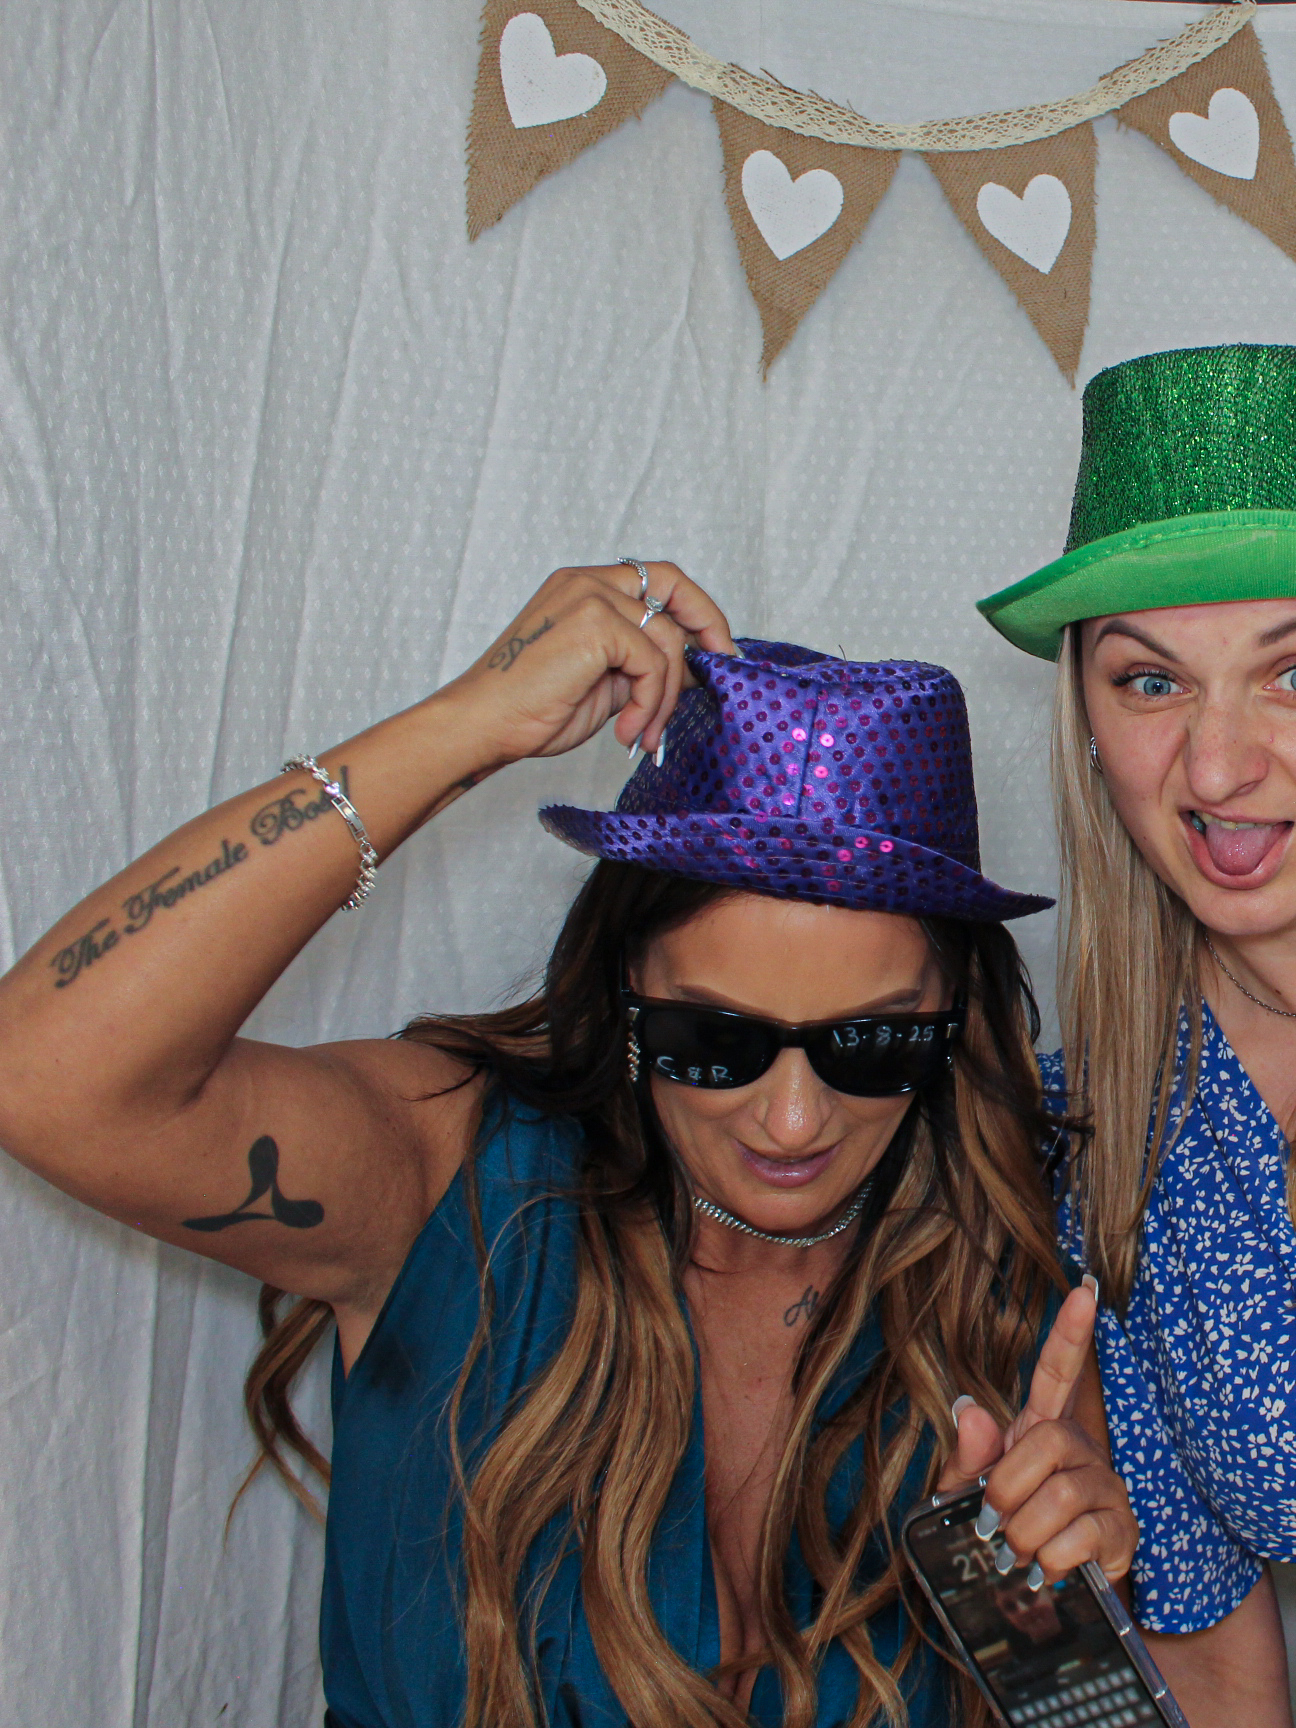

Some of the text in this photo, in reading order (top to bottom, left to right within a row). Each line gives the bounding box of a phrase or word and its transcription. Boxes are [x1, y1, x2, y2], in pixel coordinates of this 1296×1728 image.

[50, 917, 121, 990] The
[121, 838, 249, 935] Female
[656, 1055, 676, 1073] C
[711, 1065, 733, 1082] R
